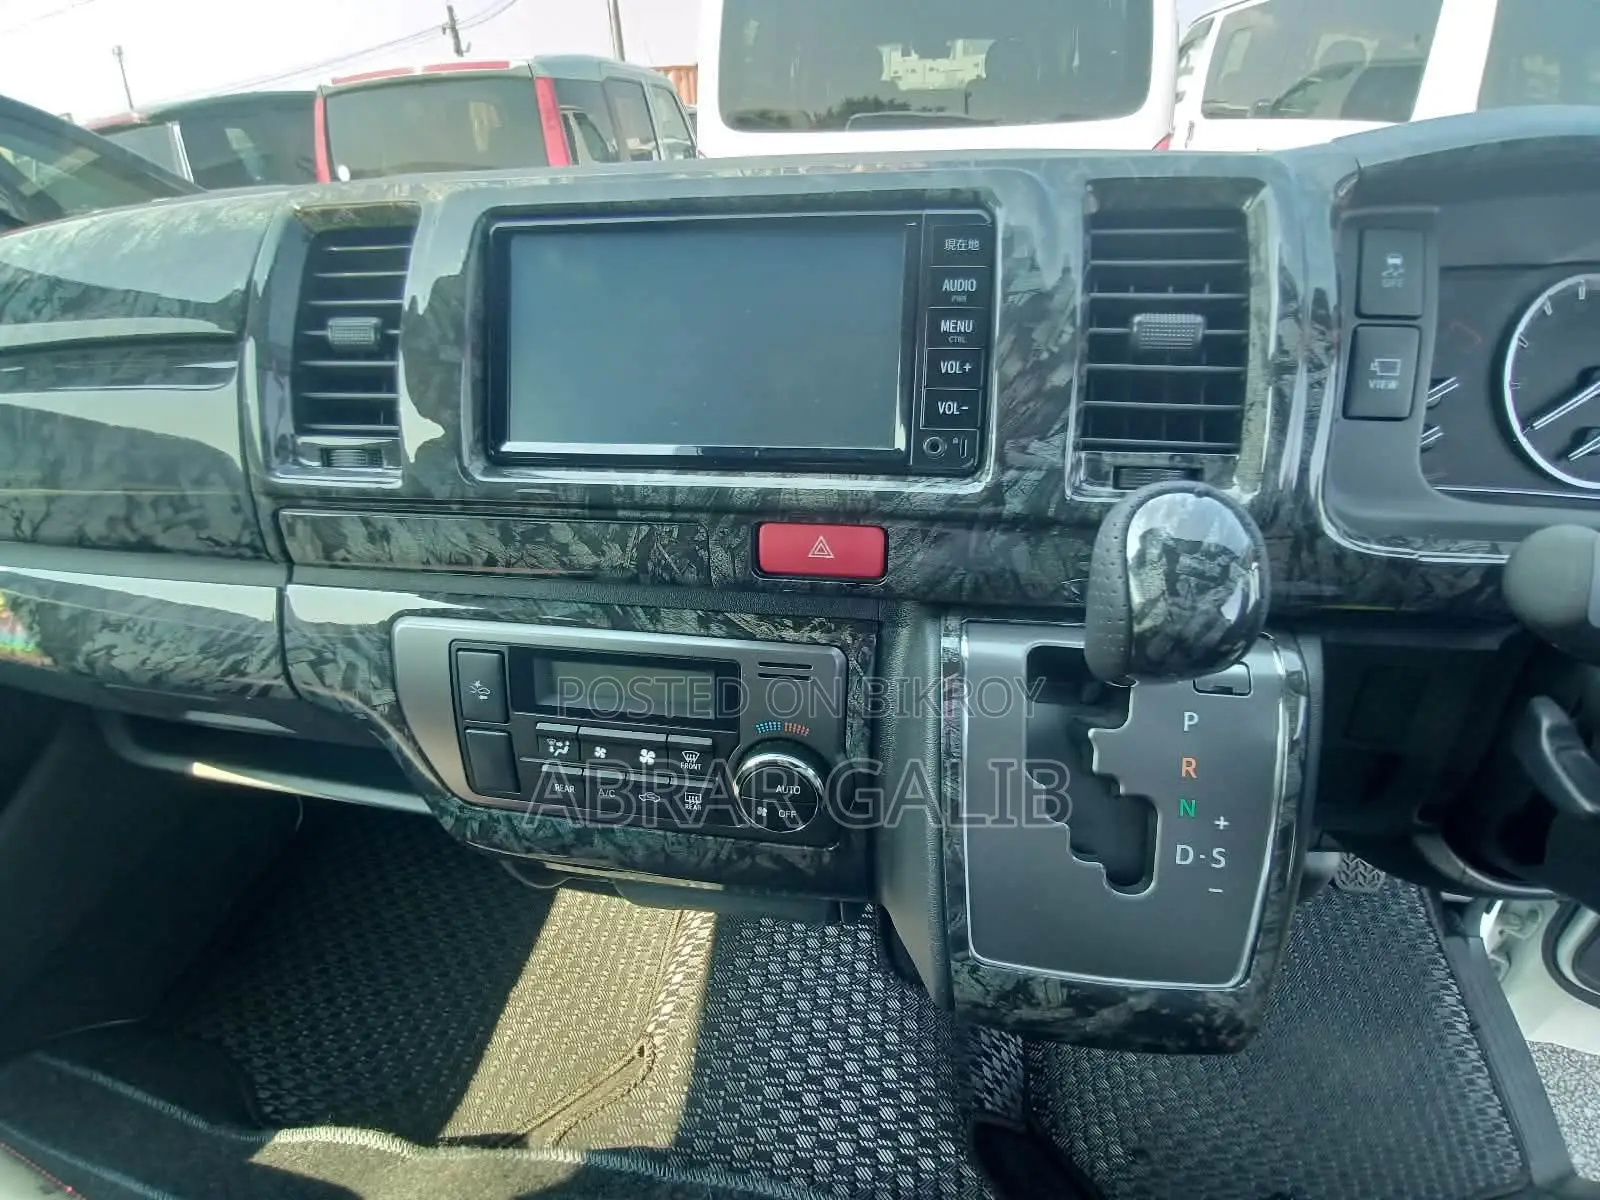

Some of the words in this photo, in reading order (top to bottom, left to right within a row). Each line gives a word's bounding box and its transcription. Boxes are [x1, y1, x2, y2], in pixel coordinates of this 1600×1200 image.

[943, 238, 980, 251] 現在地
[942, 278, 977, 292] AUDIO
[940, 319, 973, 333] MENU
[1368, 379, 1399, 390] VIEW
[1183, 711, 1199, 731] P
[680, 761, 702, 771] FRONT
[1181, 757, 1198, 779] R
[554, 782, 575, 794] REAR
[598, 786, 616, 799] A/C
[775, 783, 802, 796] AUTO
[778, 808, 797, 820] OFF
[1179, 799, 1196, 818] N
